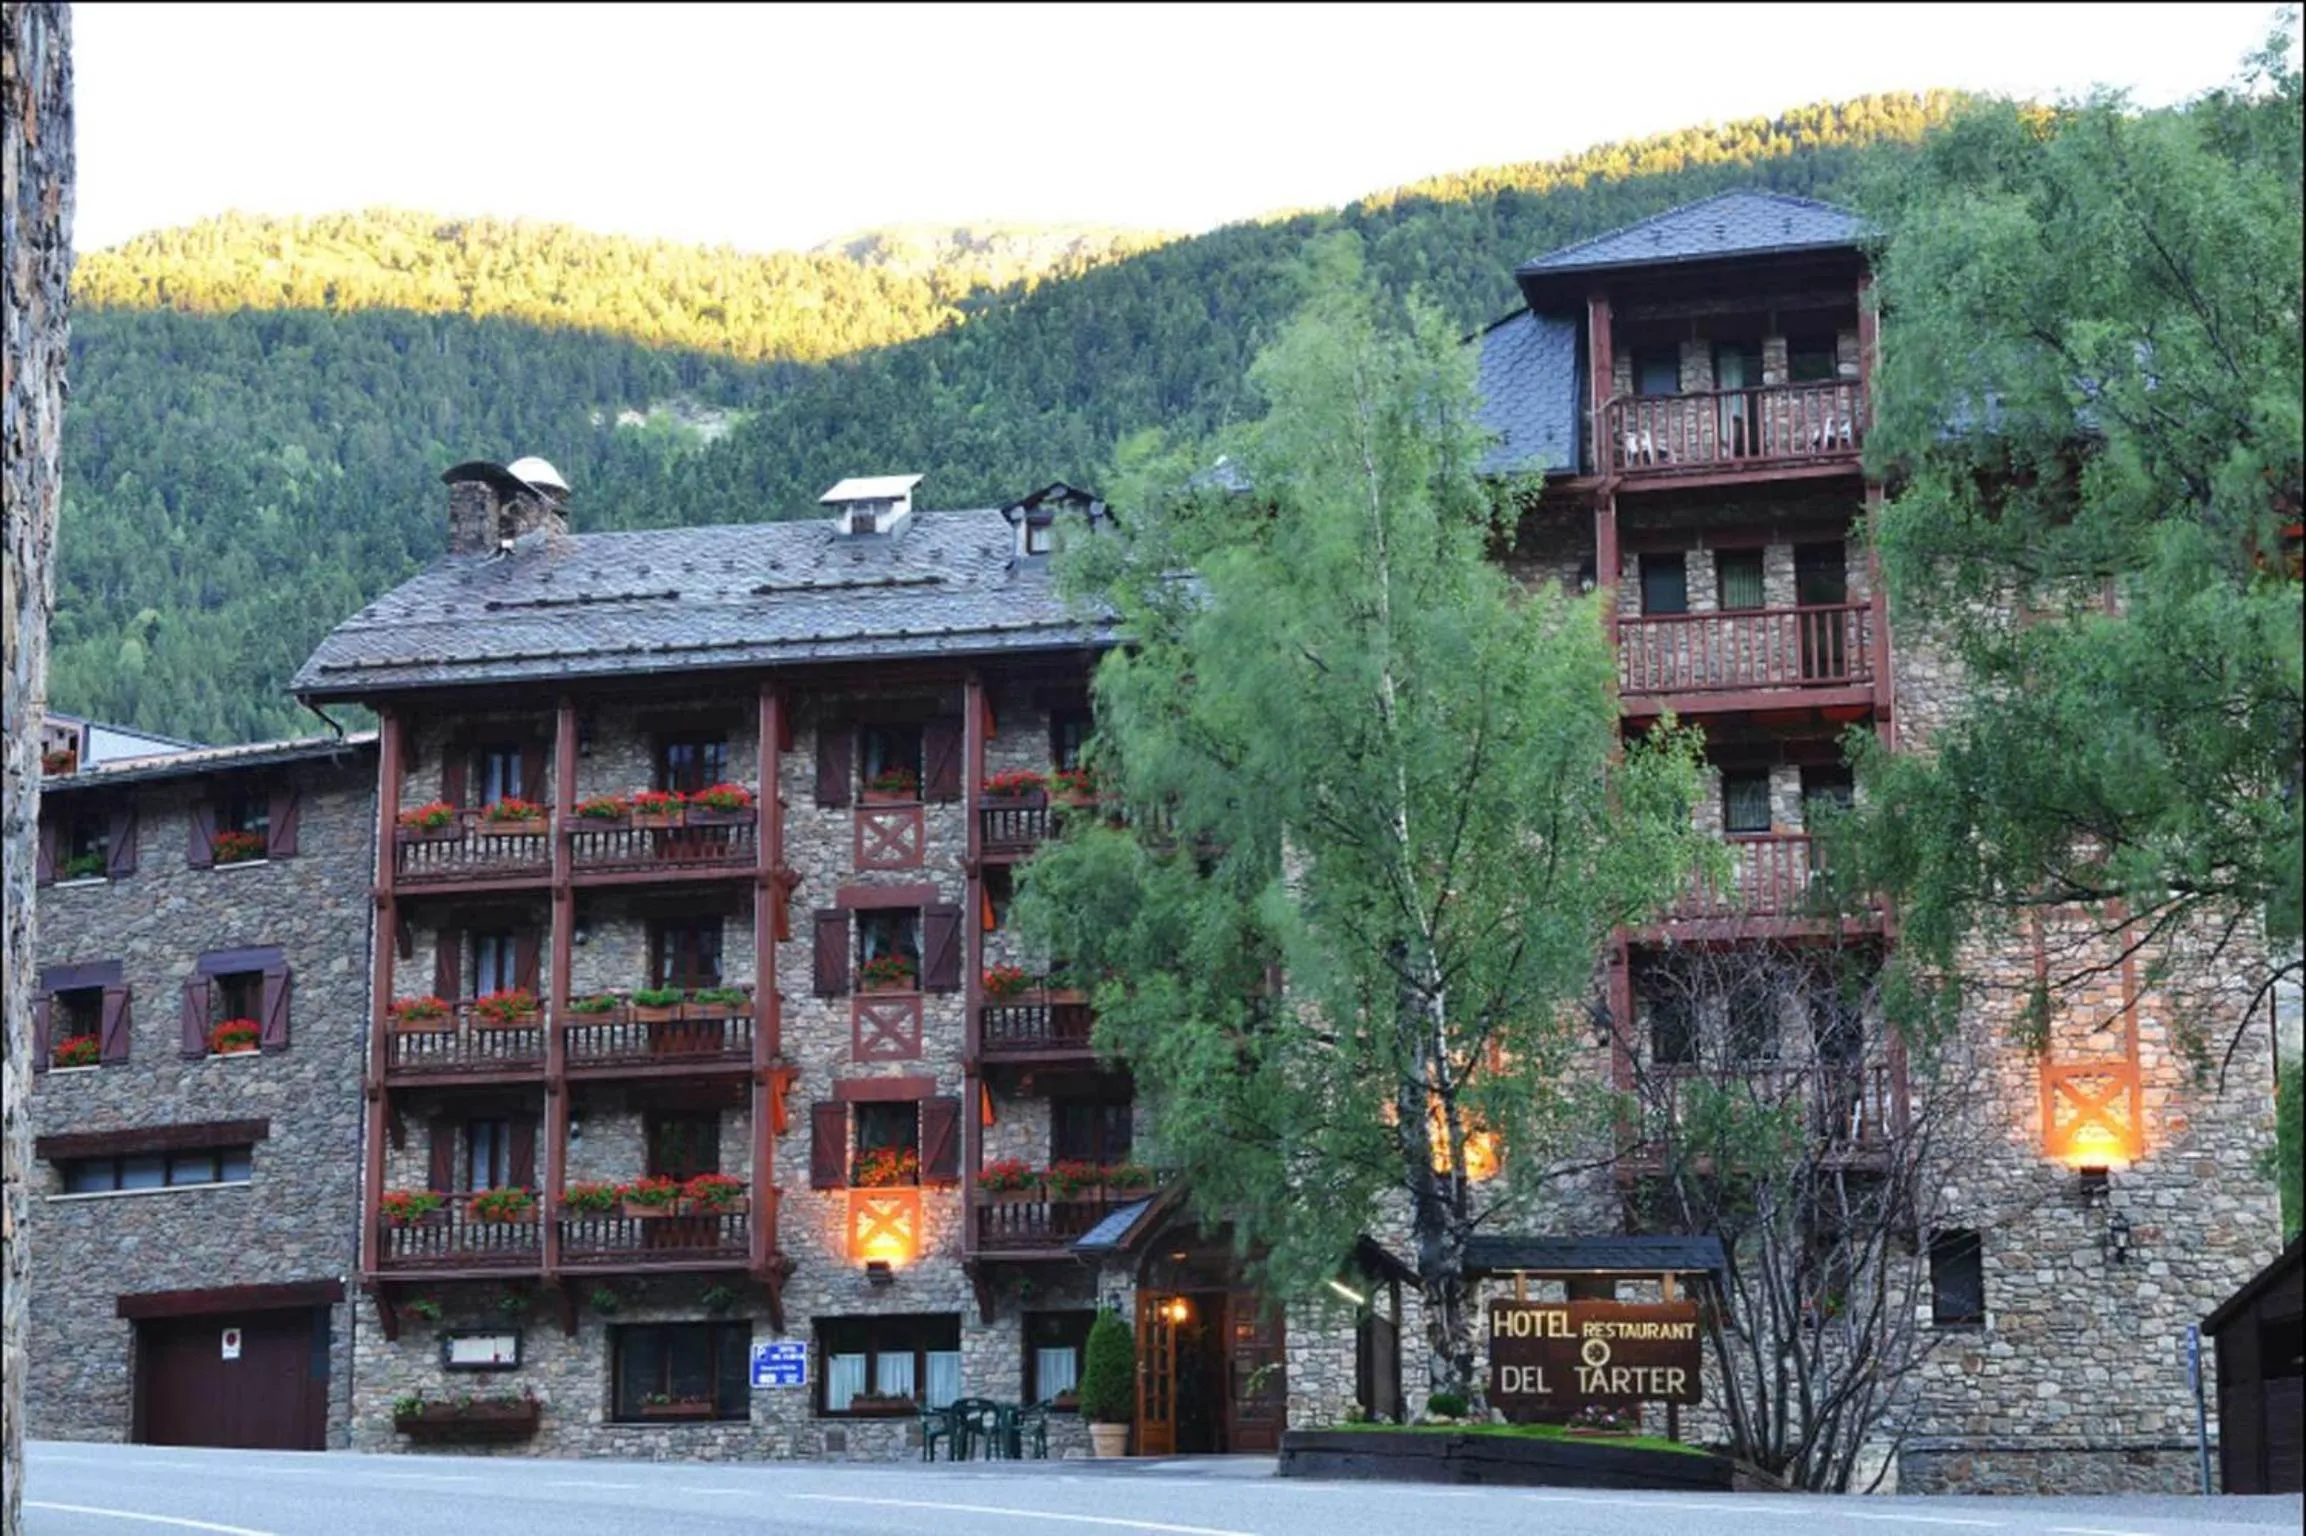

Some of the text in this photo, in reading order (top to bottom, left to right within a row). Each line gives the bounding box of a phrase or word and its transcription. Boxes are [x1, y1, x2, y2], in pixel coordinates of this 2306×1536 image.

[1493, 1310, 1696, 1340] HOTEL RESTAURANT
[1501, 1366, 1686, 1394] DEL TARTER
